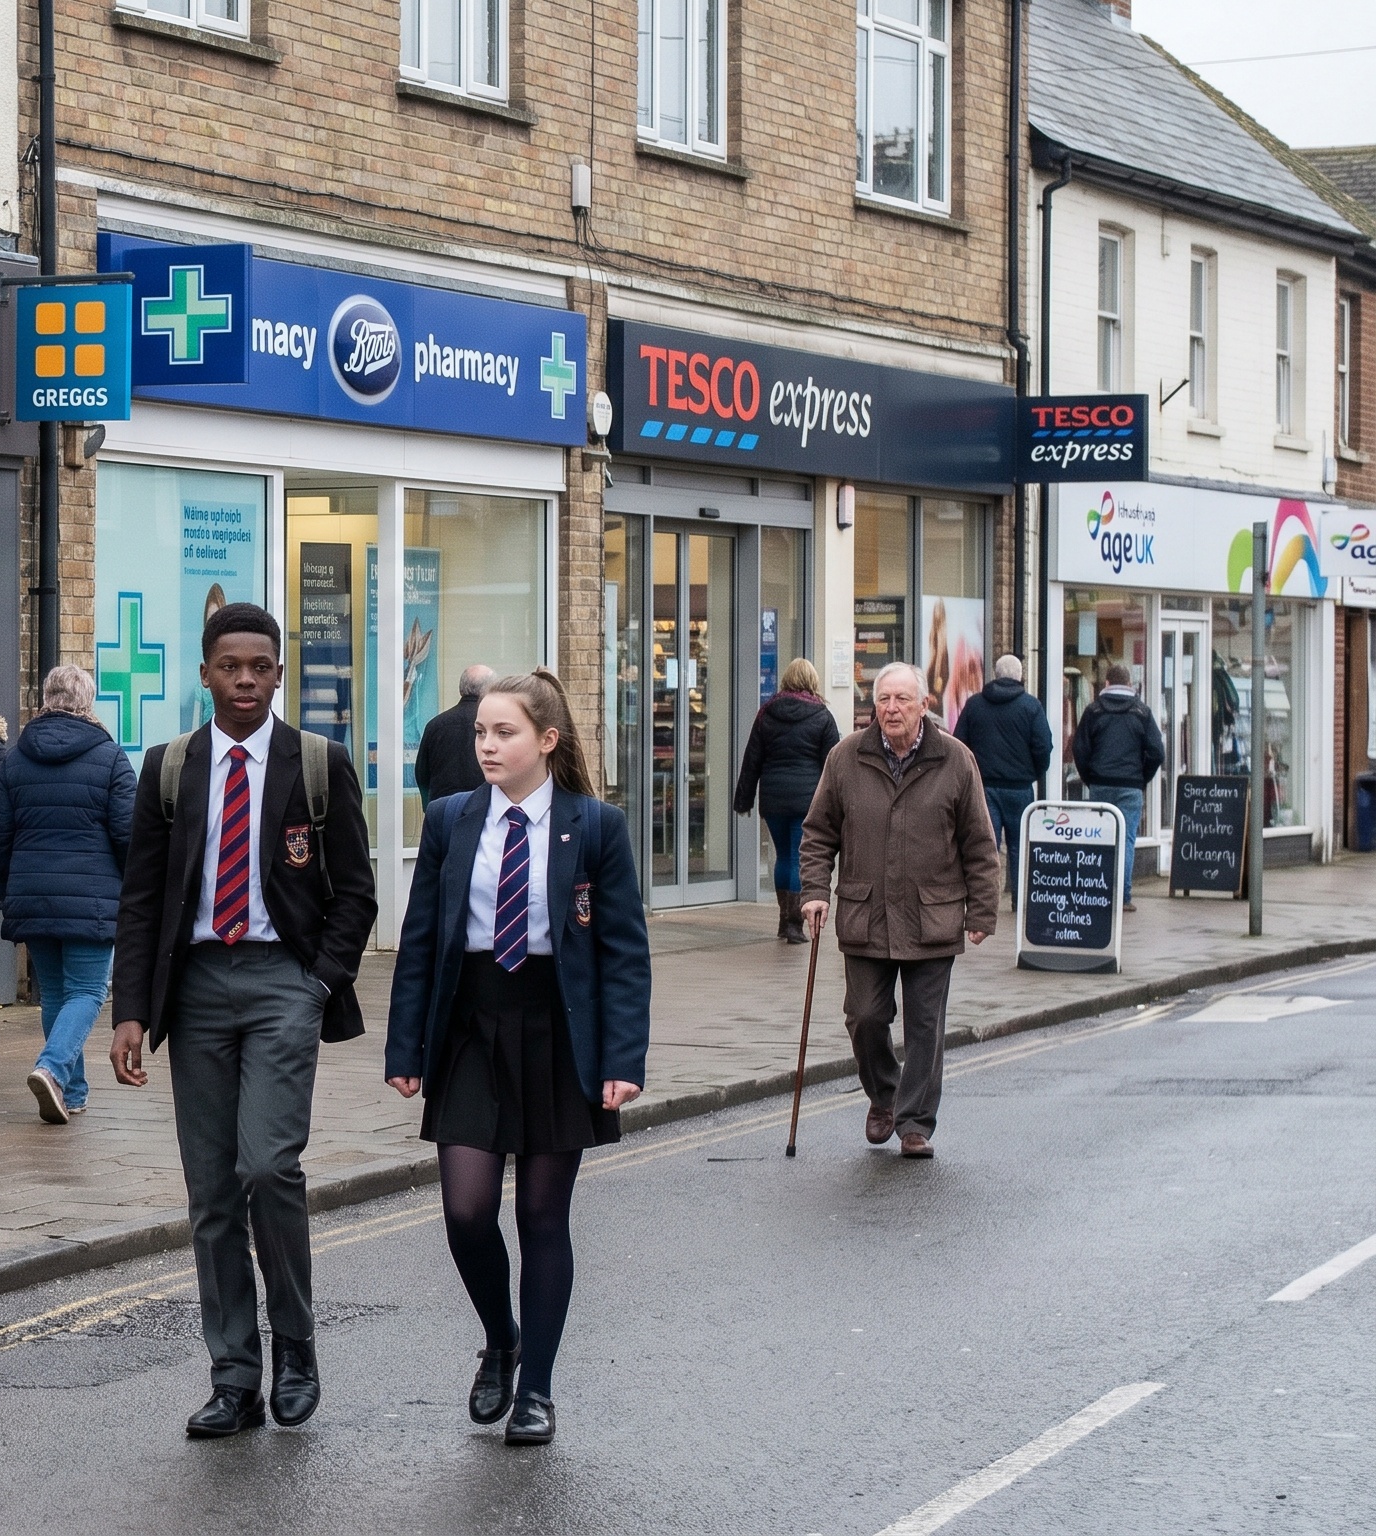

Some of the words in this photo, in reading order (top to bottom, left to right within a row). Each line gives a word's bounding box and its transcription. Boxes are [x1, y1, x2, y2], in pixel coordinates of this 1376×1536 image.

[252, 317, 317, 370] macy
[344, 318, 396, 376] Boots
[414, 334, 520, 397] pharmacy
[32, 387, 109, 408] GREGGS
[639, 344, 760, 421] TESCO
[769, 376, 872, 448] express
[1031, 405, 1134, 428] TESCO
[1030, 441, 1134, 468] express
[1101, 531, 1133, 574] age
[1135, 533, 1154, 565] UK
[1055, 826, 1083, 841] age
[1085, 827, 1102, 838] UK
